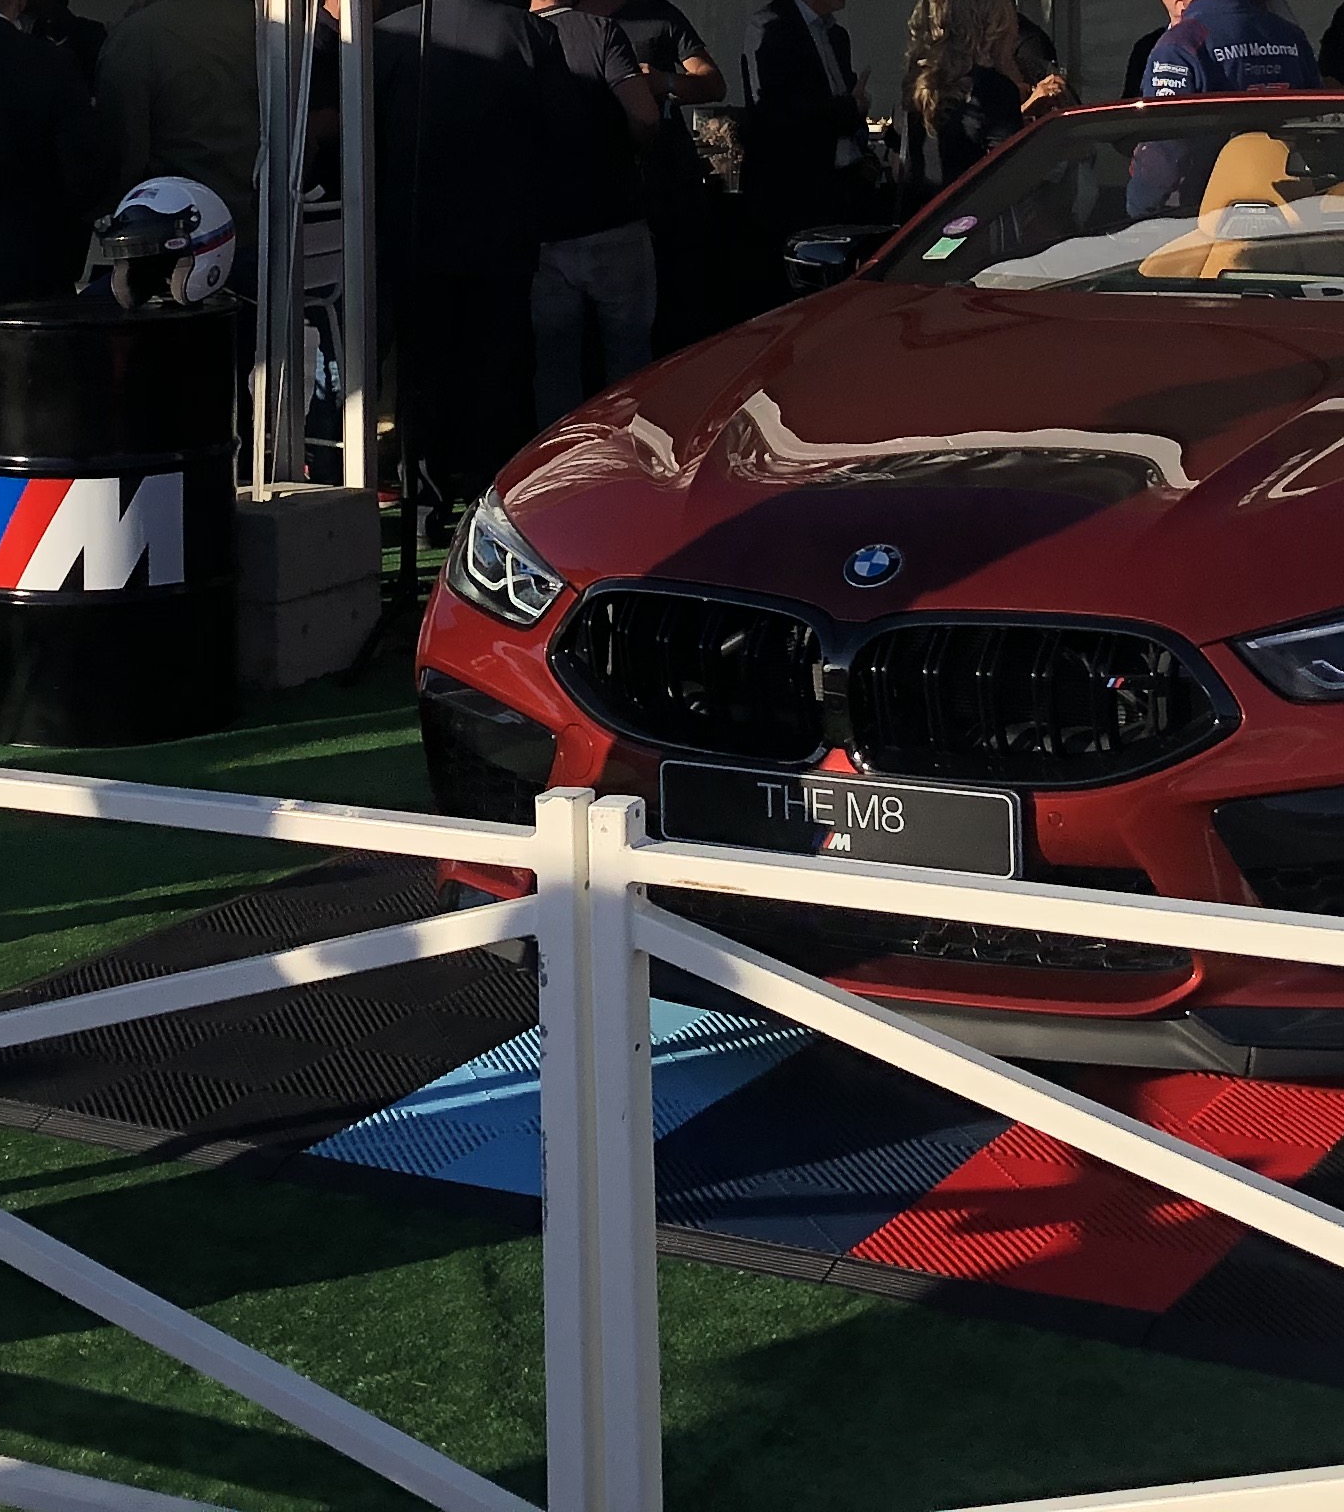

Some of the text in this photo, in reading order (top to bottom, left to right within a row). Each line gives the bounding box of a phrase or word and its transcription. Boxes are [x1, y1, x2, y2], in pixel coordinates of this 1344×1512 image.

[1214, 44, 1248, 62] BMW
[15, 472, 185, 591] M
[757, 782, 905, 833] THE M8
[826, 832, 851, 853] M
